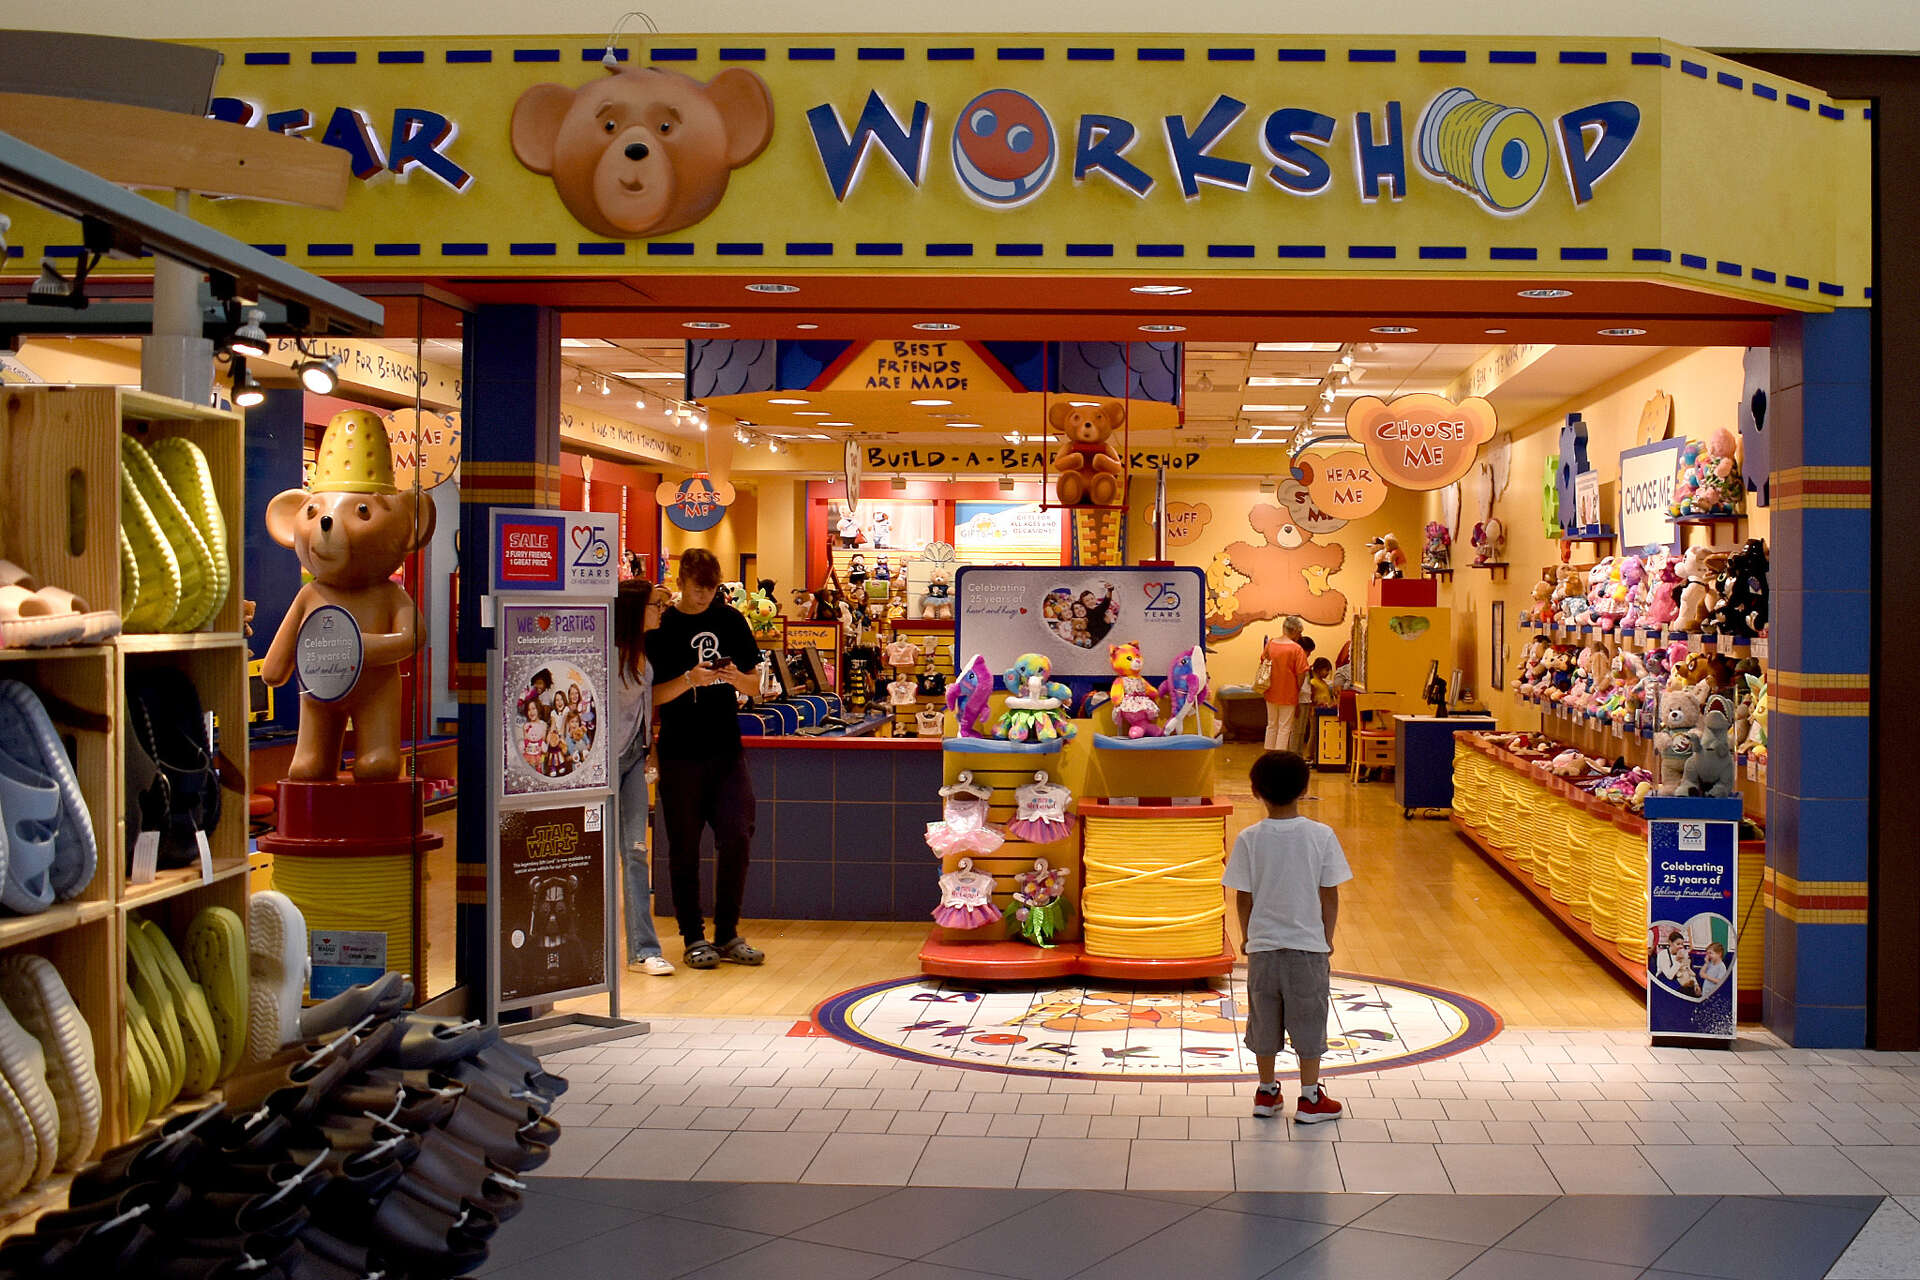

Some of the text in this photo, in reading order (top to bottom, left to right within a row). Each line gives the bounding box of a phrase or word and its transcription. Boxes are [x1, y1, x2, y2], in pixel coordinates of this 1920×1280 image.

[211, 88, 1642, 213] AR WORKSHOP
[893, 341, 948, 358] BEST
[865, 374, 968, 391] ARE MADE
[1376, 420, 1465, 441] CHOOSE
[395, 451, 427, 469] ME
[1403, 440, 1444, 469] ME
[1326, 468, 1373, 483] HEAR
[674, 491, 721, 503] DRESS
[1333, 485, 1363, 505] ME
[1625, 480, 1657, 515] CHOOSE
[1658, 475, 1671, 508] ME
[685, 503, 709, 518] ME
[1167, 512, 1198, 524] LUFF
[1307, 506, 1334, 523] M
[509, 532, 549, 549] SALE
[1168, 527, 1189, 538] ME
[571, 525, 610, 567] 25
[571, 568, 610, 578] YEARS
[967, 583, 1026, 594] Celebrating
[1143, 582, 1181, 611] 25
[969, 594, 983, 603] 25
[516, 615, 533, 633] WE
[304, 637, 353, 650] Celebrating
[306, 652, 317, 662] 25
[528, 824, 578, 840] STAR
[1682, 824, 1702, 840] 25
[527, 838, 578, 858] WARS
[1660, 860, 1725, 875] Celebrating
[1663, 874, 1721, 887] 25 years of
